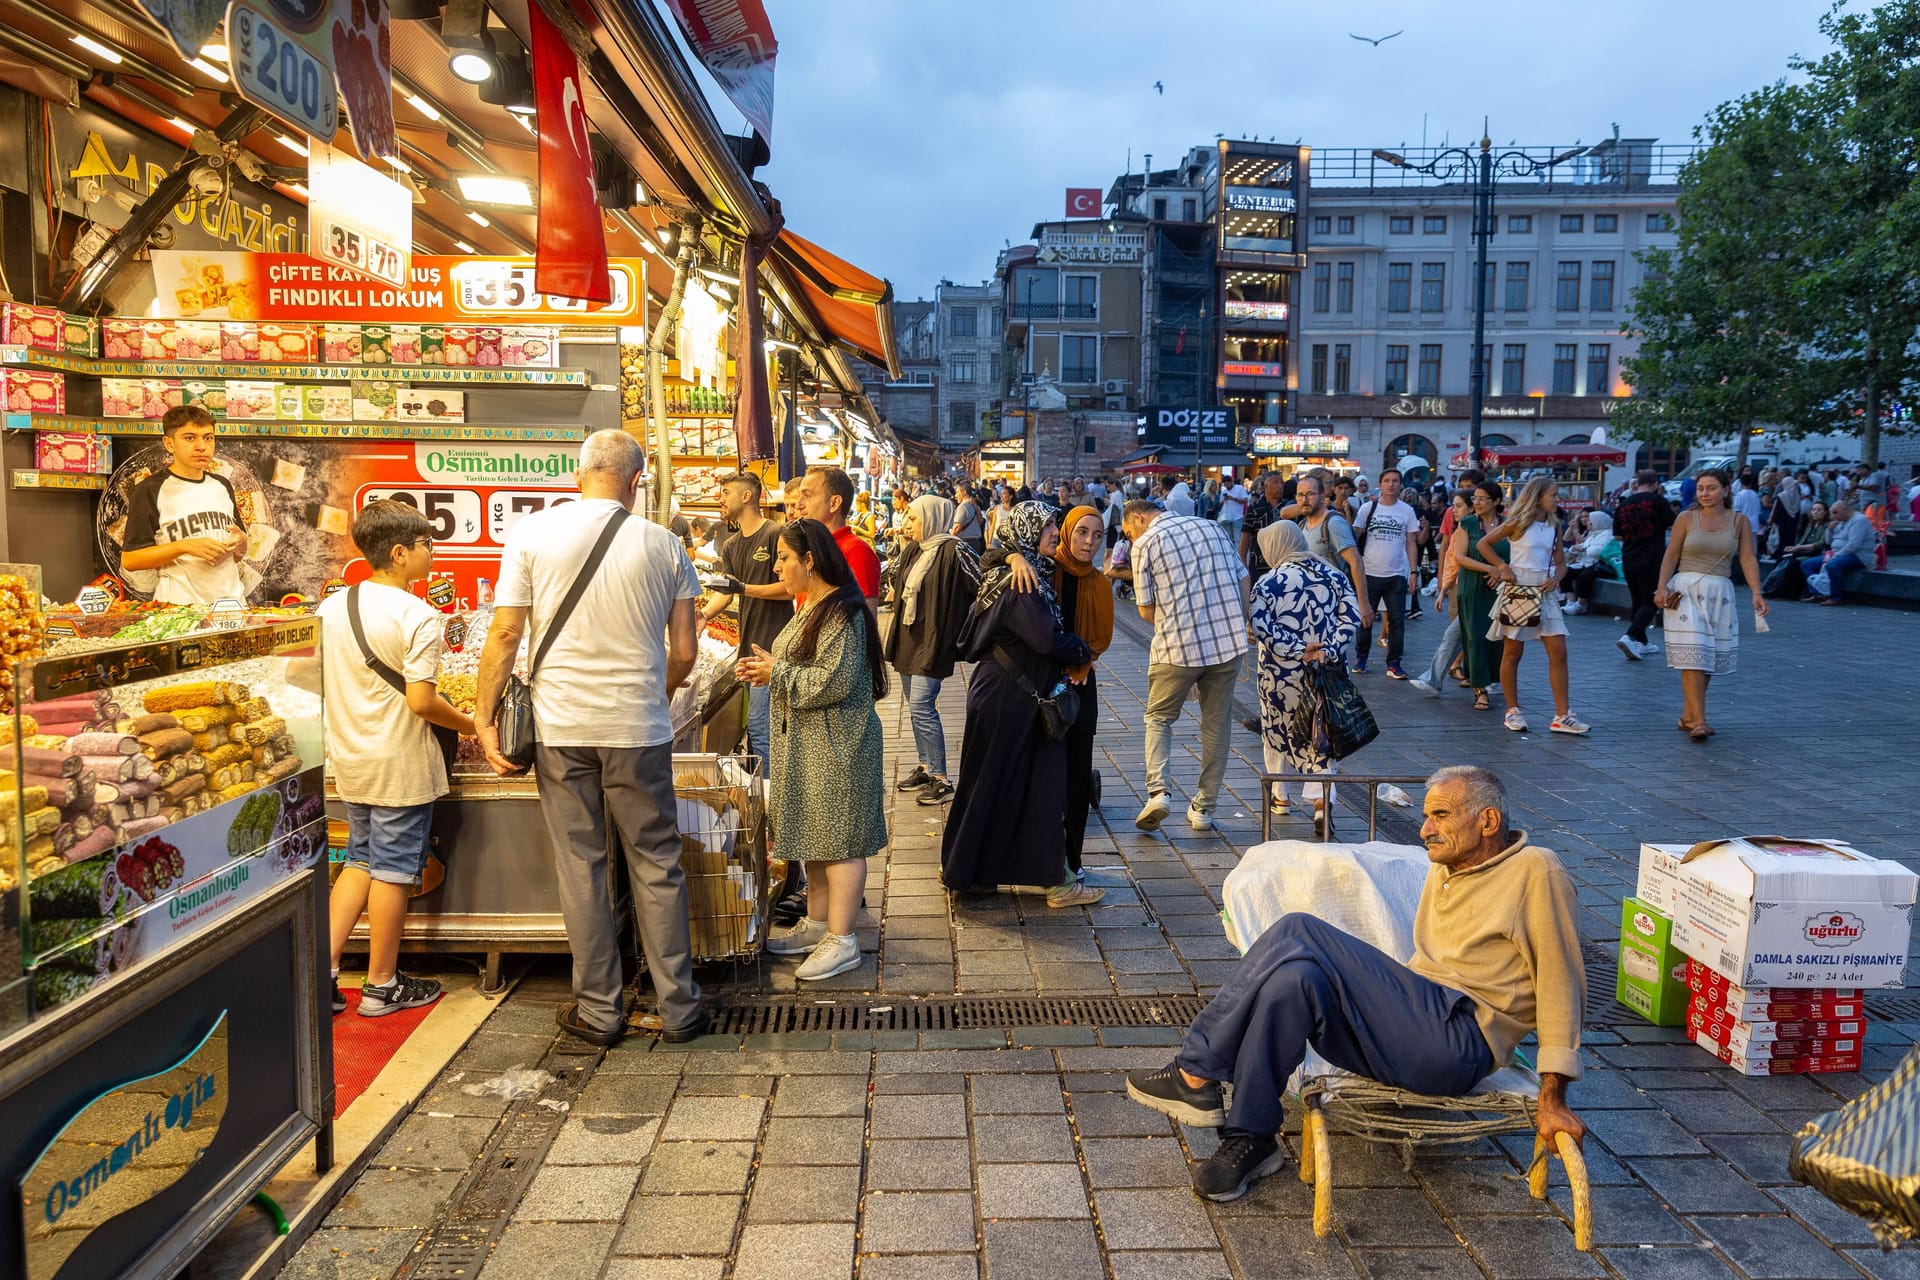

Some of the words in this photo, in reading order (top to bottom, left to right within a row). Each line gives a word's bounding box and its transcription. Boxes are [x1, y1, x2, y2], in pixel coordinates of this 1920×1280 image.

[240, 16, 251, 58] KG
[257, 23, 319, 120] 200
[1229, 194, 1296, 208] LENTEBUR
[332, 226, 360, 265] 35
[375, 244, 398, 279] 70
[269, 262, 323, 283] ÇİFTE
[269, 288, 363, 307] FINDIKLI
[369, 290, 443, 308] LOKUM
[448, 449, 489, 457] Eminönü
[494, 503, 504, 521] KG
[254, 631, 286, 651] TURKISH
[286, 626, 315, 645] DELIGHT
[169, 864, 249, 919] Osmanlıoğlu
[1809, 925, 1858, 939] uğurlu
[1754, 953, 1793, 965] DAMLA
[1796, 954, 1840, 966] SAKIZLI
[1843, 952, 1904, 968] PİŞMANİYE
[1786, 972, 1805, 981] 240
[1825, 972, 1837, 981] 24
[1840, 972, 1864, 981] Adet
